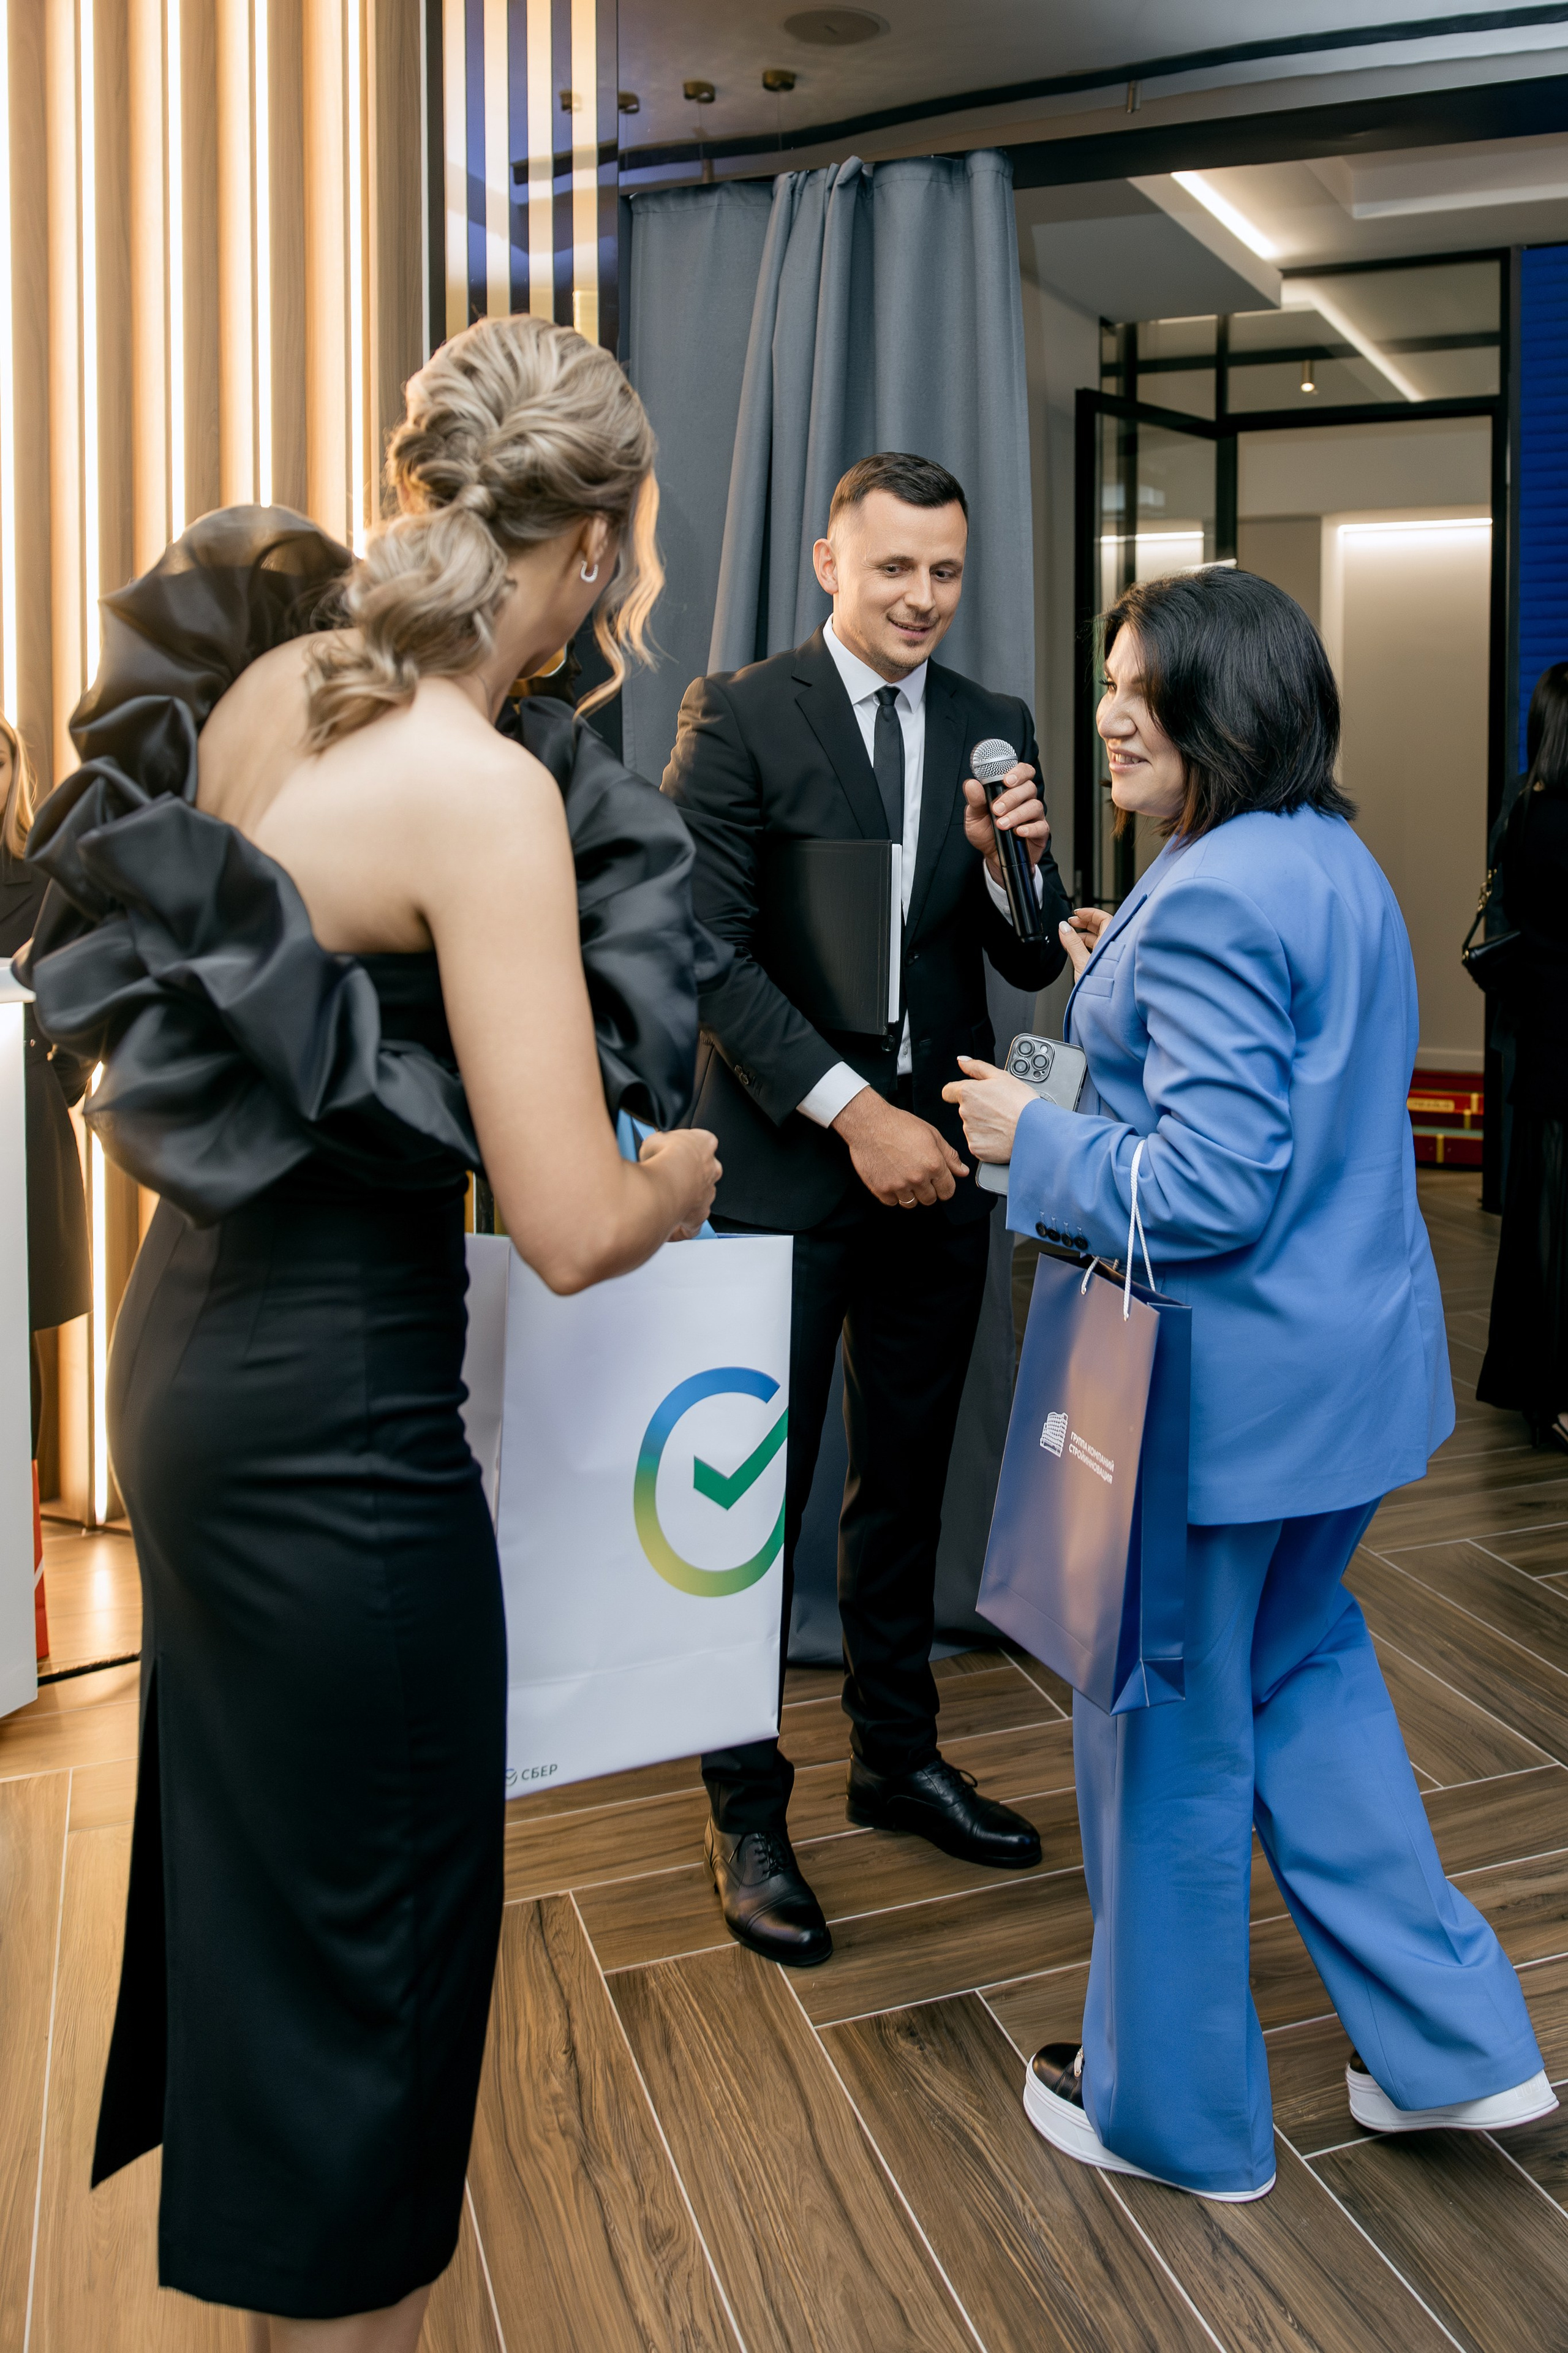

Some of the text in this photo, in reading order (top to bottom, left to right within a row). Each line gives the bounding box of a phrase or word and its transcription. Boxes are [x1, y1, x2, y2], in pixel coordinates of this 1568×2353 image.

[1068, 1443, 1113, 1484] СТРОЙИННОВАЦИЯ
[1070, 1431, 1115, 1472] ГРУППА КОМПАНИЙ
[521, 1764, 558, 1781] СБЕР
